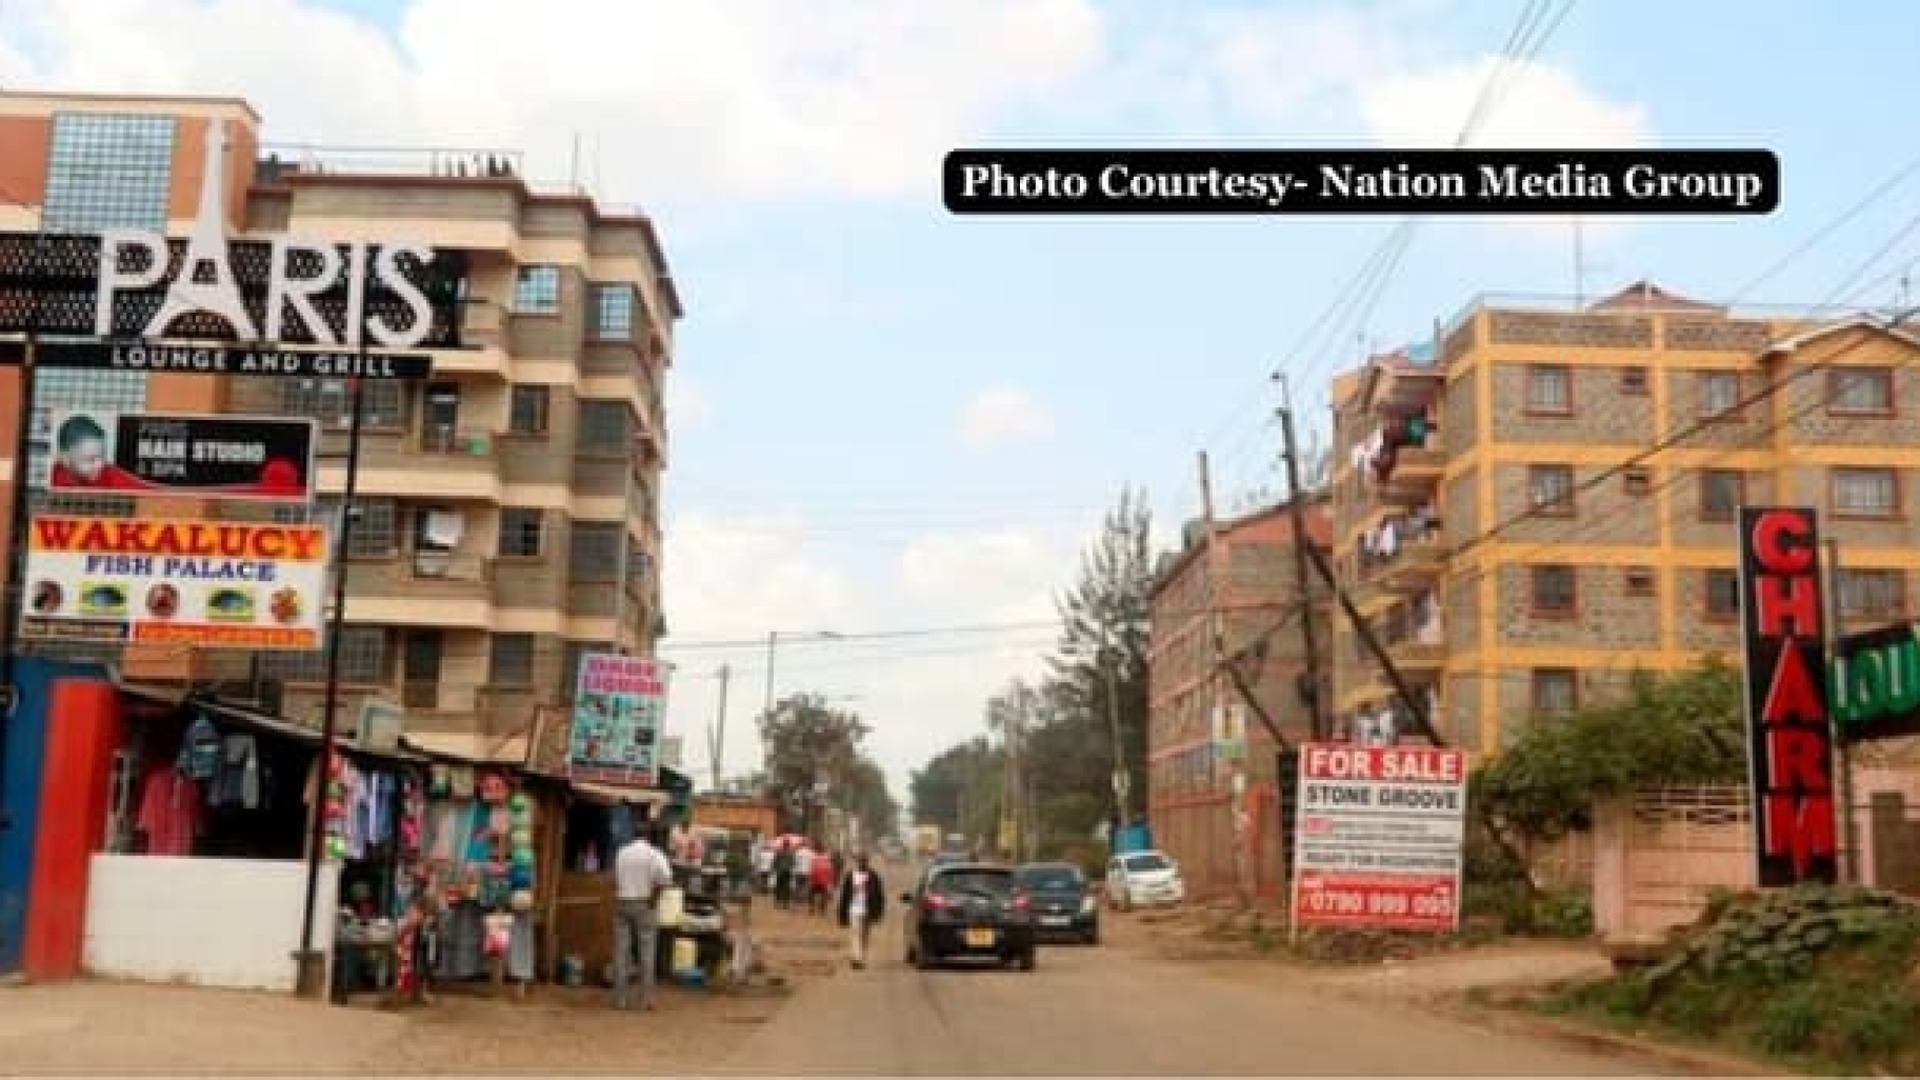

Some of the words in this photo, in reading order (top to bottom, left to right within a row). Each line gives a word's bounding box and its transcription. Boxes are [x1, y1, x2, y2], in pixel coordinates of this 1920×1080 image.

[94, 118, 434, 346] PARIS
[112, 346, 226, 369] LOUNGE
[239, 353, 300, 372] AND
[312, 355, 397, 377] GRILL
[138, 438, 187, 460] HAIR
[192, 441, 266, 463] STUDIO
[35, 518, 323, 560] WAKALUCY
[84, 554, 152, 576] FISH
[164, 557, 277, 583] PALACE
[1752, 510, 1837, 879] CHARM
[1309, 749, 1371, 777] FOR
[1382, 752, 1458, 781] SALE
[1306, 784, 1372, 807] STONE
[1378, 788, 1458, 810] GROOVE
